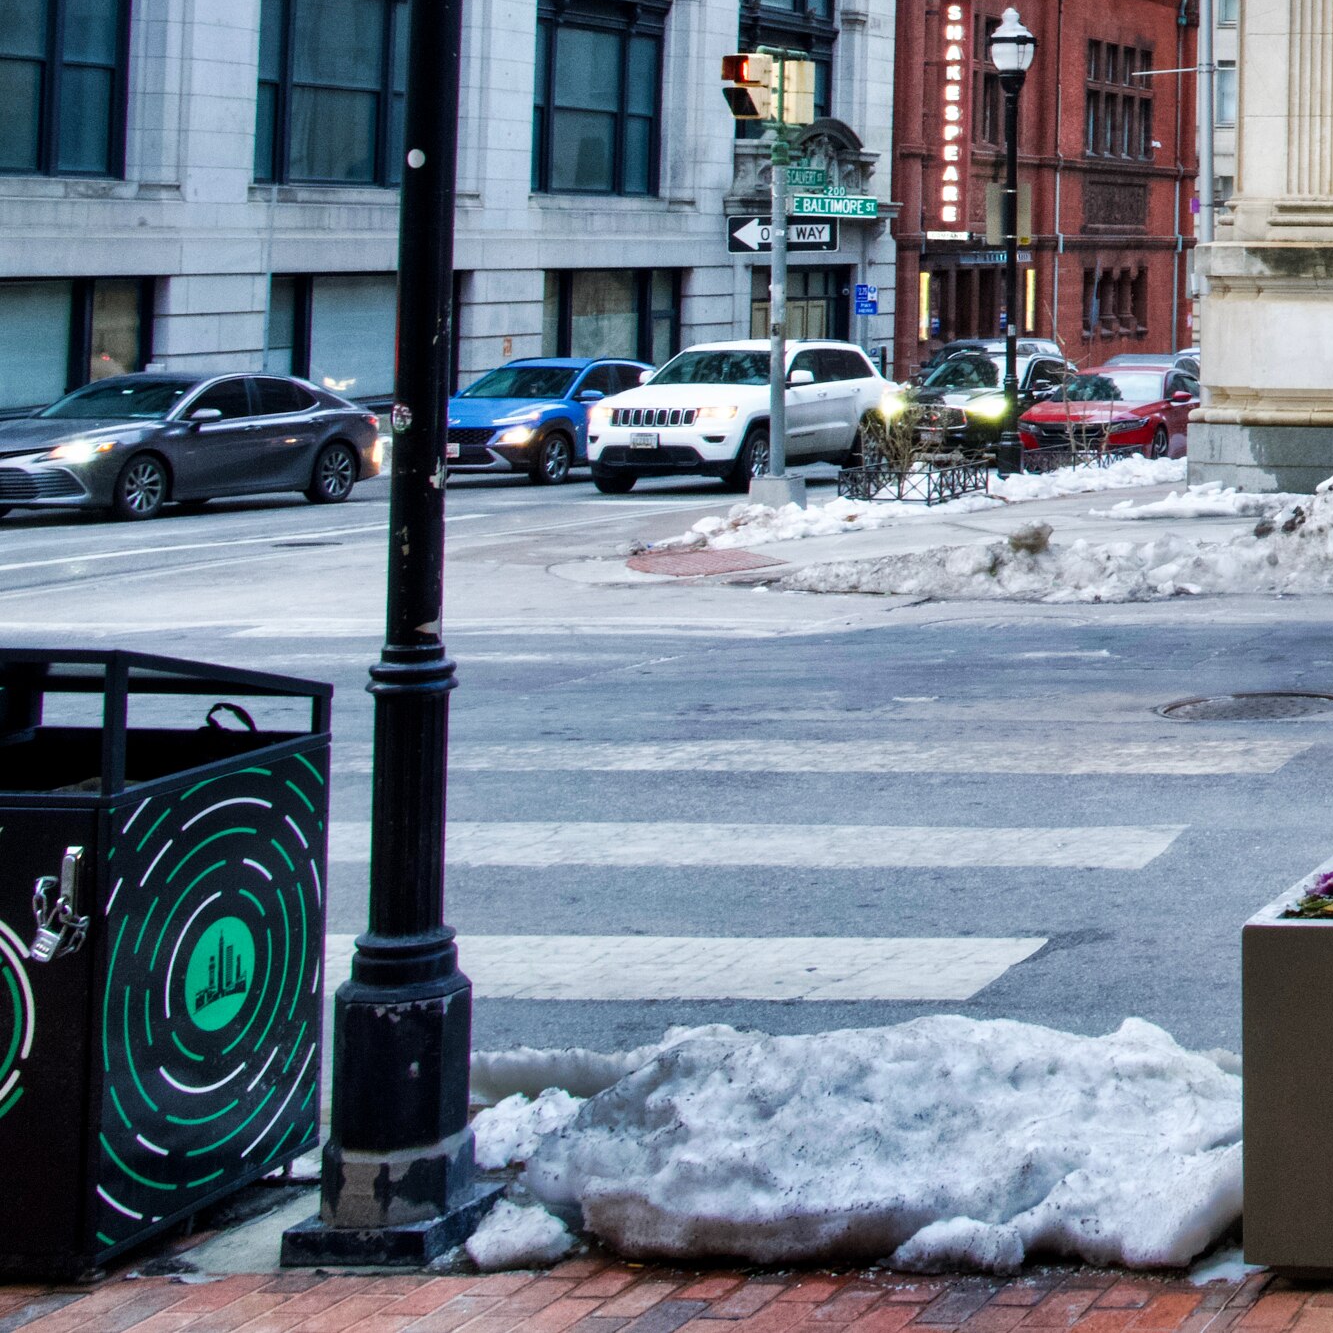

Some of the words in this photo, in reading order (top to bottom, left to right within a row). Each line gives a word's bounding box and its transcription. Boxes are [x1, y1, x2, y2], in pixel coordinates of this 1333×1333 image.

[942, 5, 962, 222] SHAKESPEARE
[791, 170, 817, 184] CALVERT
[827, 187, 846, 196] 200
[794, 198, 800, 212] E
[803, 198, 864, 214] BALTIMORE
[796, 226, 825, 240] WAY
